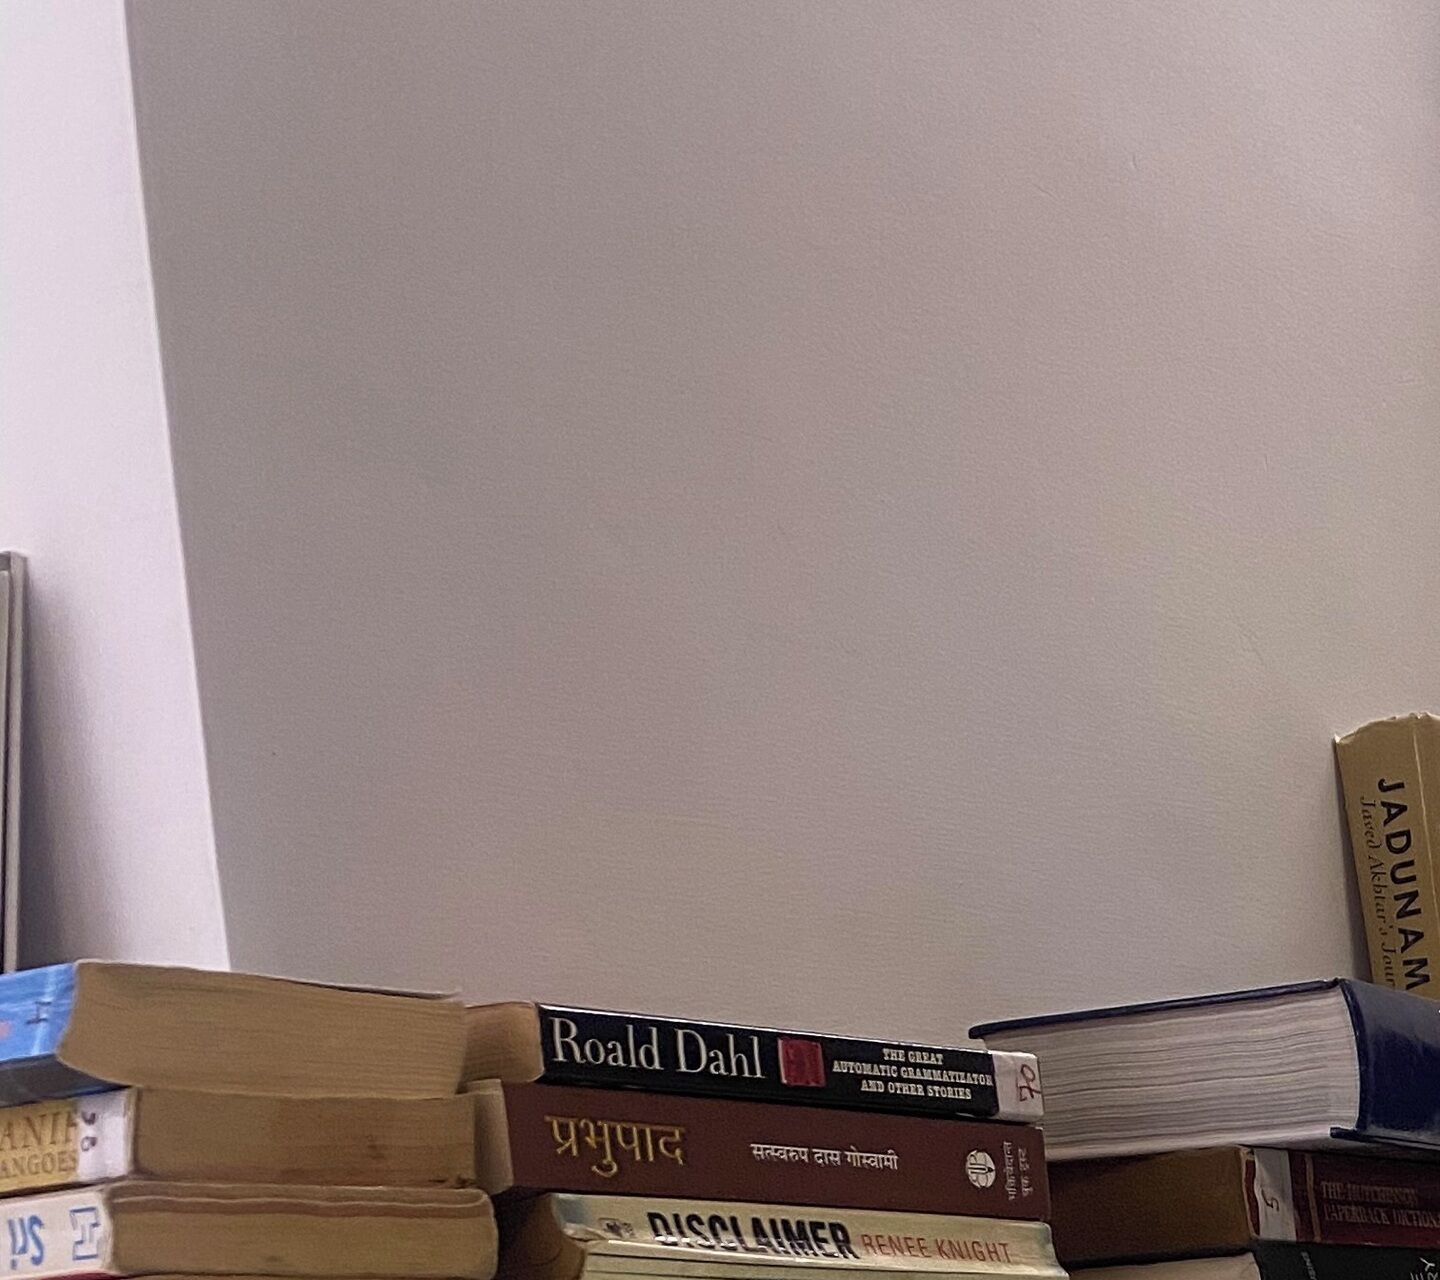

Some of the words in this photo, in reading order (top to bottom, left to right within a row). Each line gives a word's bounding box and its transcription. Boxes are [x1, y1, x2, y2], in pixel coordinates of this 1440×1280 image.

[550, 1017, 664, 1070] Roald
[675, 1028, 766, 1079] Dahl
[882, 1048, 906, 1062] THE
[908, 1052, 944, 1065] GREAT
[832, 1060, 898, 1078] AUTOMATIC
[861, 1079, 885, 1092] AND
[888, 1083, 925, 1097] OTHER
[927, 1086, 972, 1100] STORIES
[544, 1115, 686, 1178] प्रभुपाद
[811, 1148, 841, 1168] दास
[845, 1145, 899, 1171] गोस्वामी
[648, 1212, 860, 1260] DISCLAIMER
[861, 1234, 928, 1259] RENEE
[935, 1239, 1014, 1264] KNIGHT
